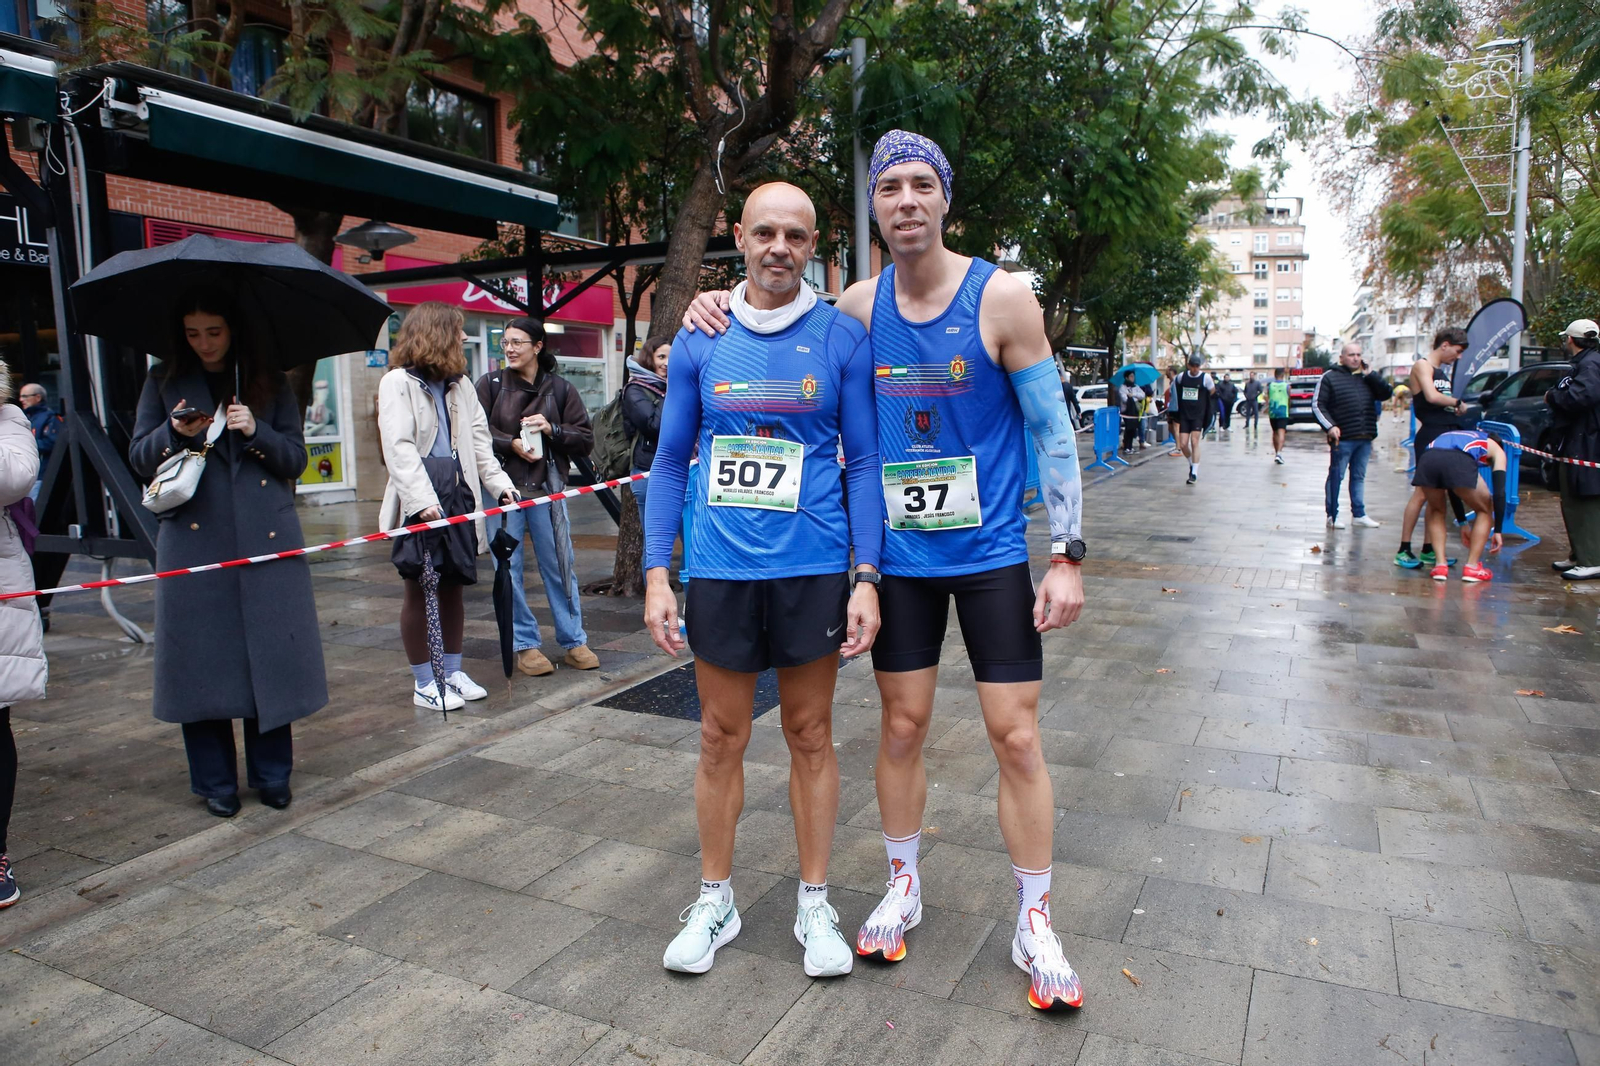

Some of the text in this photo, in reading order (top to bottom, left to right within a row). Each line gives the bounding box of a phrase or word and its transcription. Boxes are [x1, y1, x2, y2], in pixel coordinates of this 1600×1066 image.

[0, 248, 49, 263] e & Bar
[1475, 320, 1516, 361] CUPRA
[727, 443, 754, 453] CARRERA
[755, 444, 785, 456] NAVIDAD
[717, 460, 787, 490] 507
[897, 467, 927, 480] CARRERA
[928, 464, 957, 477] NAVIDAD
[904, 483, 949, 512] 37
